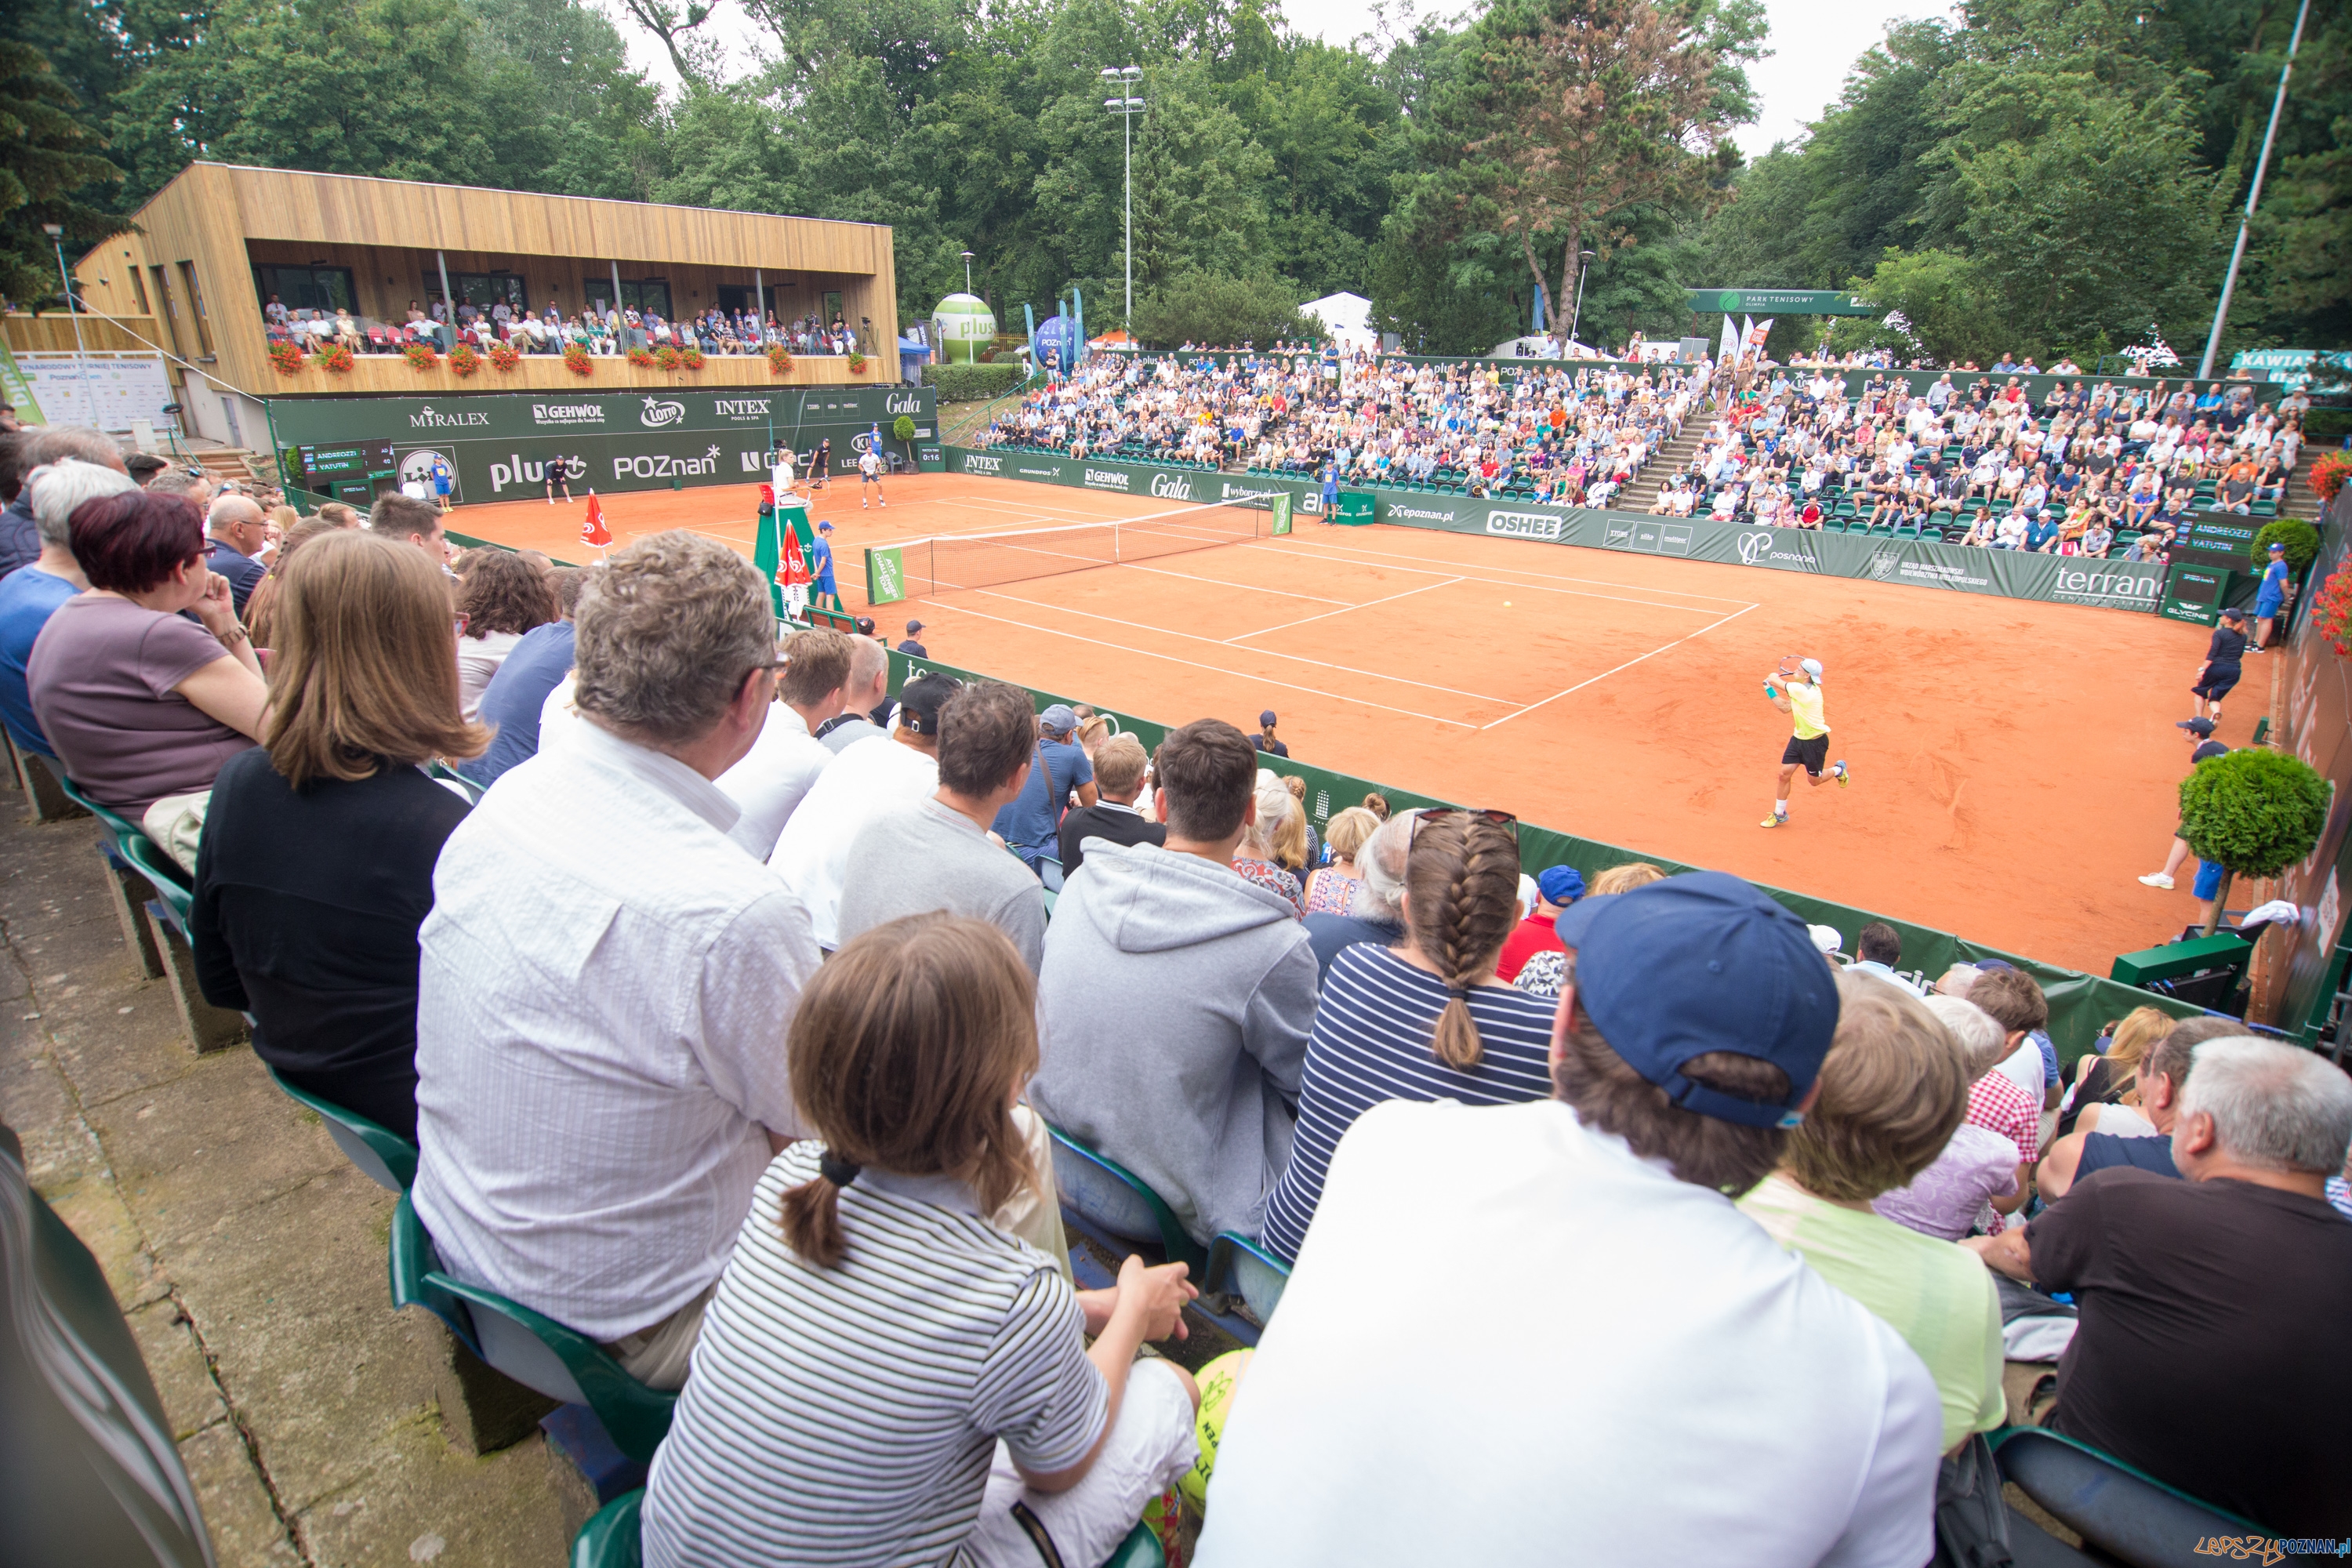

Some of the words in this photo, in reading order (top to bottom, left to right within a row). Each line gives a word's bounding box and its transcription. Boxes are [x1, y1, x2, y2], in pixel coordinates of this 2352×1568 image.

[960, 318, 993, 338] plus
[549, 404, 604, 418] GEHWOL
[714, 399, 770, 416] INTEX
[886, 393, 921, 415] Gala
[648, 405, 677, 423] LOTTO
[841, 459, 858, 468] LEE
[965, 454, 1000, 471] INTEX
[490, 454, 551, 492] plu
[1094, 471, 1129, 485] GEHWOL
[1150, 473, 1191, 500] Gala
[1403, 508, 1454, 523] epoznan.pl
[1491, 514, 1558, 535] OSHEE
[2191, 538, 2233, 551] VATUTIN
[1769, 551, 1816, 564] posnania
[1901, 561, 1919, 570] URZĄD
[874, 553, 898, 599] CHALLENGER
[879, 575, 891, 596] TOUR
[2052, 593, 2107, 604] CENTRUM
[2113, 599, 2154, 608] CERAM
[2167, 608, 2210, 620] GLYCINE
